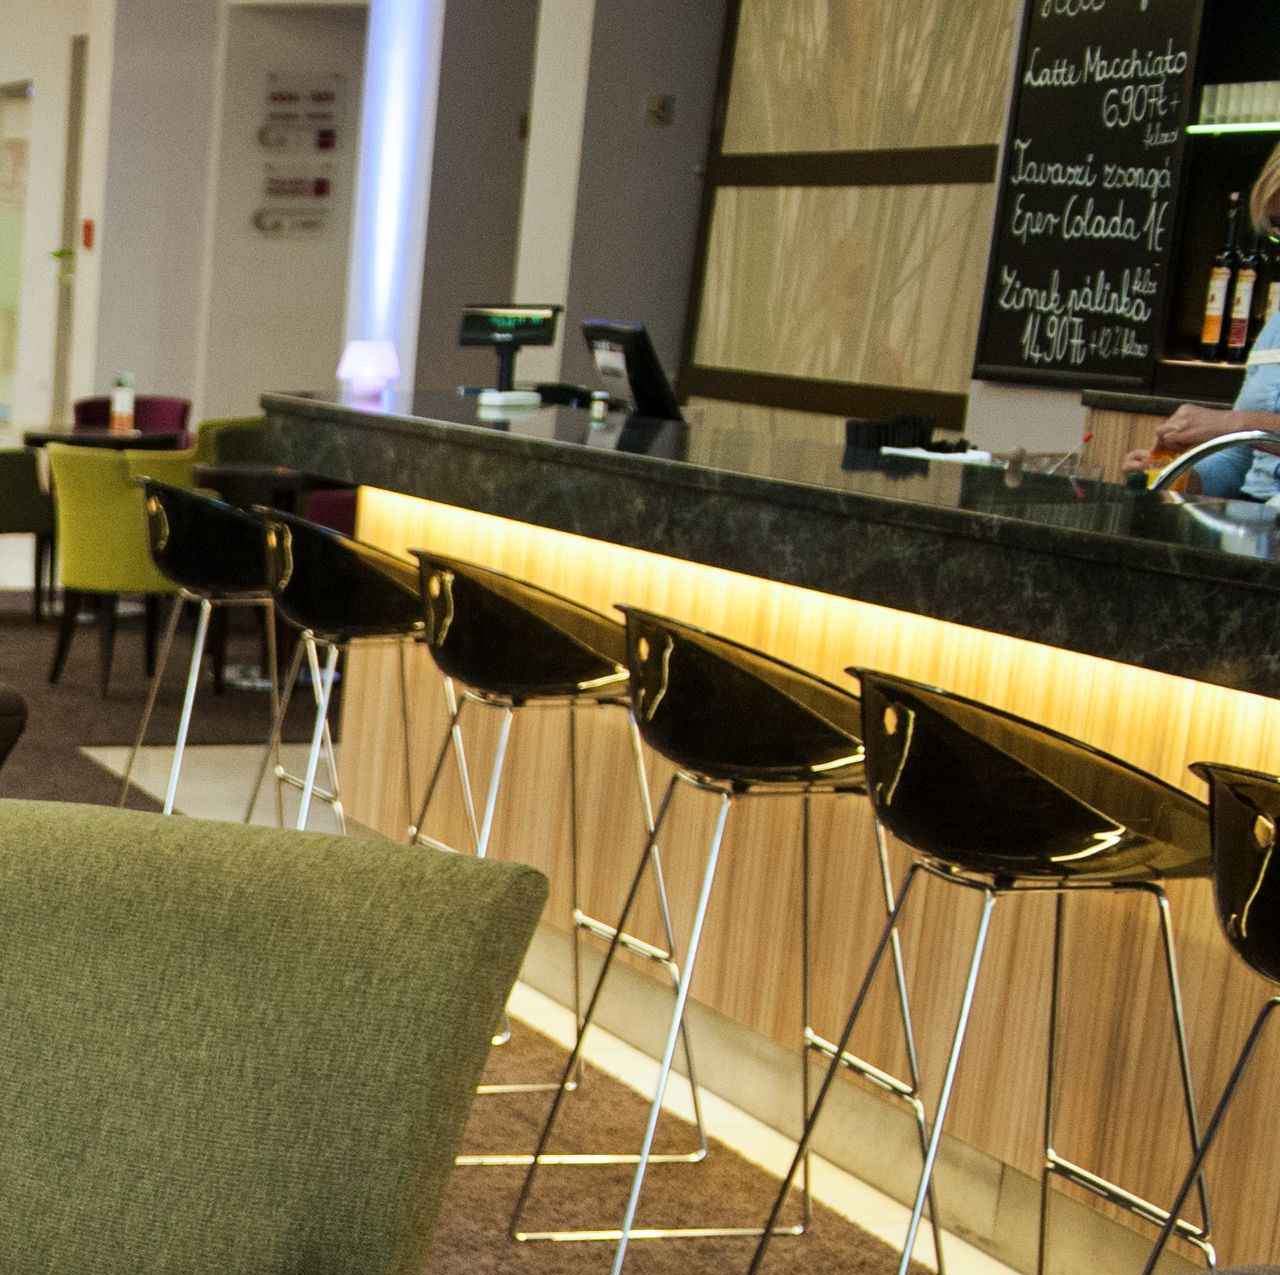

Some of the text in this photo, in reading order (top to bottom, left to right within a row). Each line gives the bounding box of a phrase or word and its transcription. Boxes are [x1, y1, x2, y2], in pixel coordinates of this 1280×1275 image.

[1024, 38, 1188, 86] Latte Macchiato
[1011, 138, 1098, 185] Tavaszi
[1011, 193, 1060, 244] Eper
[1061, 195, 1141, 241] Colada
[1066, 268, 1151, 322] pálinka
